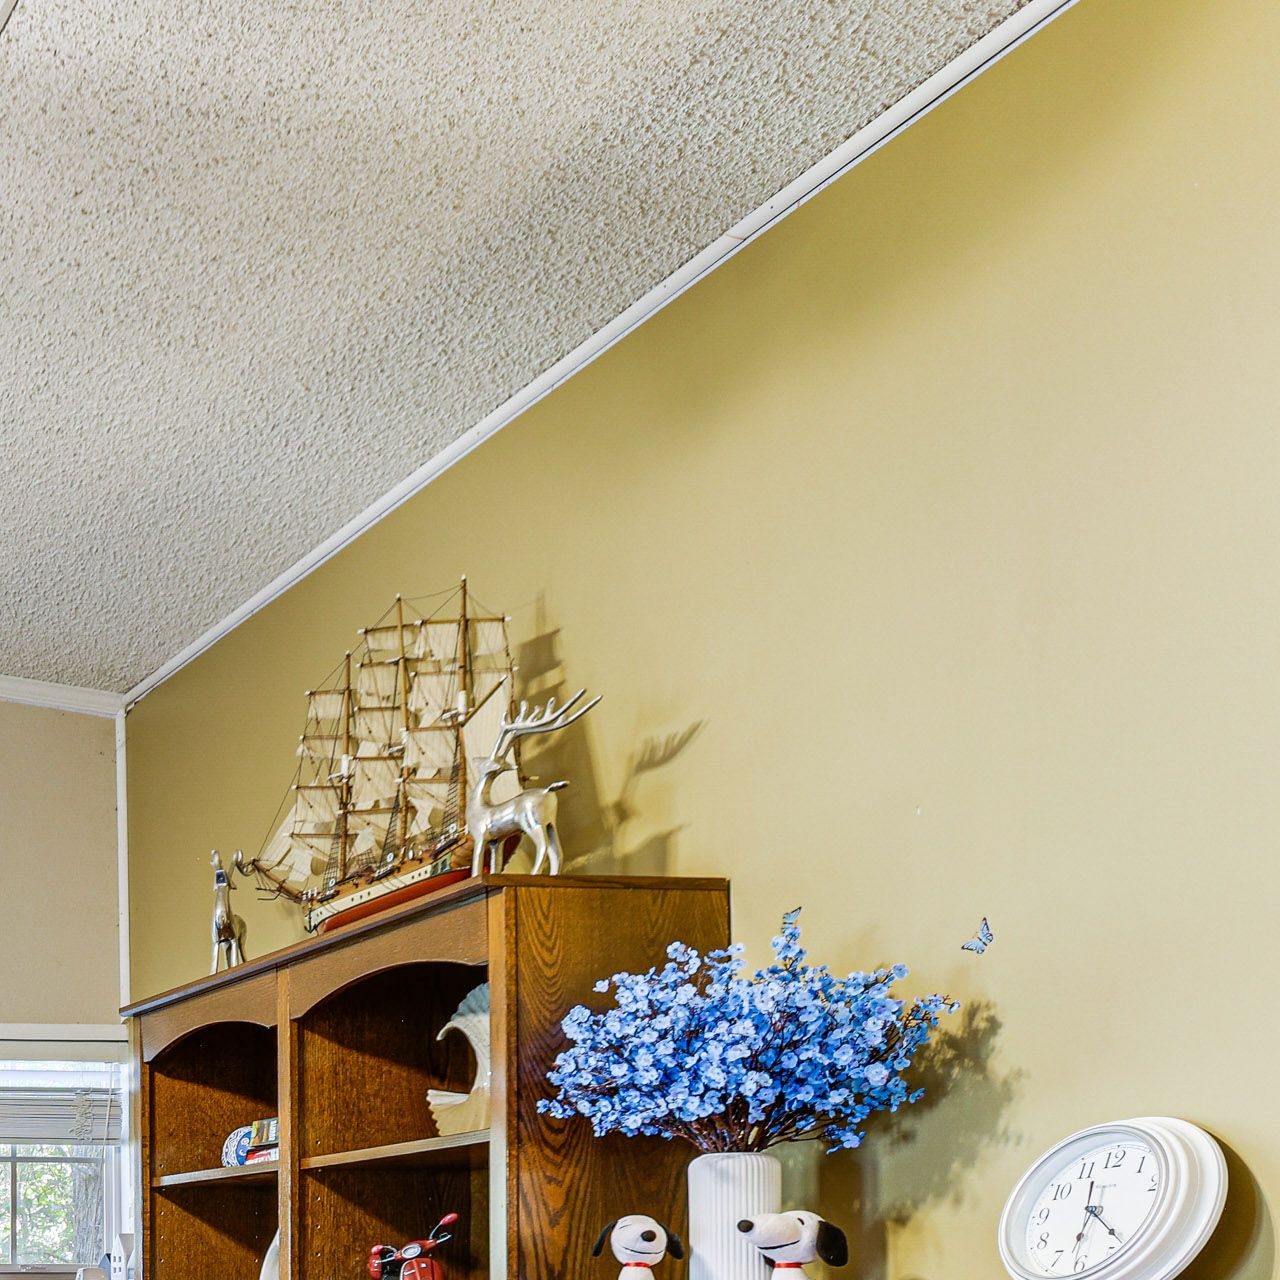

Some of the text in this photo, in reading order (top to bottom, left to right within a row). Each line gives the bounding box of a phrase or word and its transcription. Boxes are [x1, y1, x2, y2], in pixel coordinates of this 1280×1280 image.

[1103, 1149, 1126, 1170] 12
[1136, 1155, 1146, 1174] 1
[1076, 1162, 1095, 1180] 11
[1052, 1183, 1072, 1201] 10
[1036, 1209, 1050, 1226] 9
[1037, 1232, 1050, 1250] 8
[1051, 1250, 1064, 1268] 7
